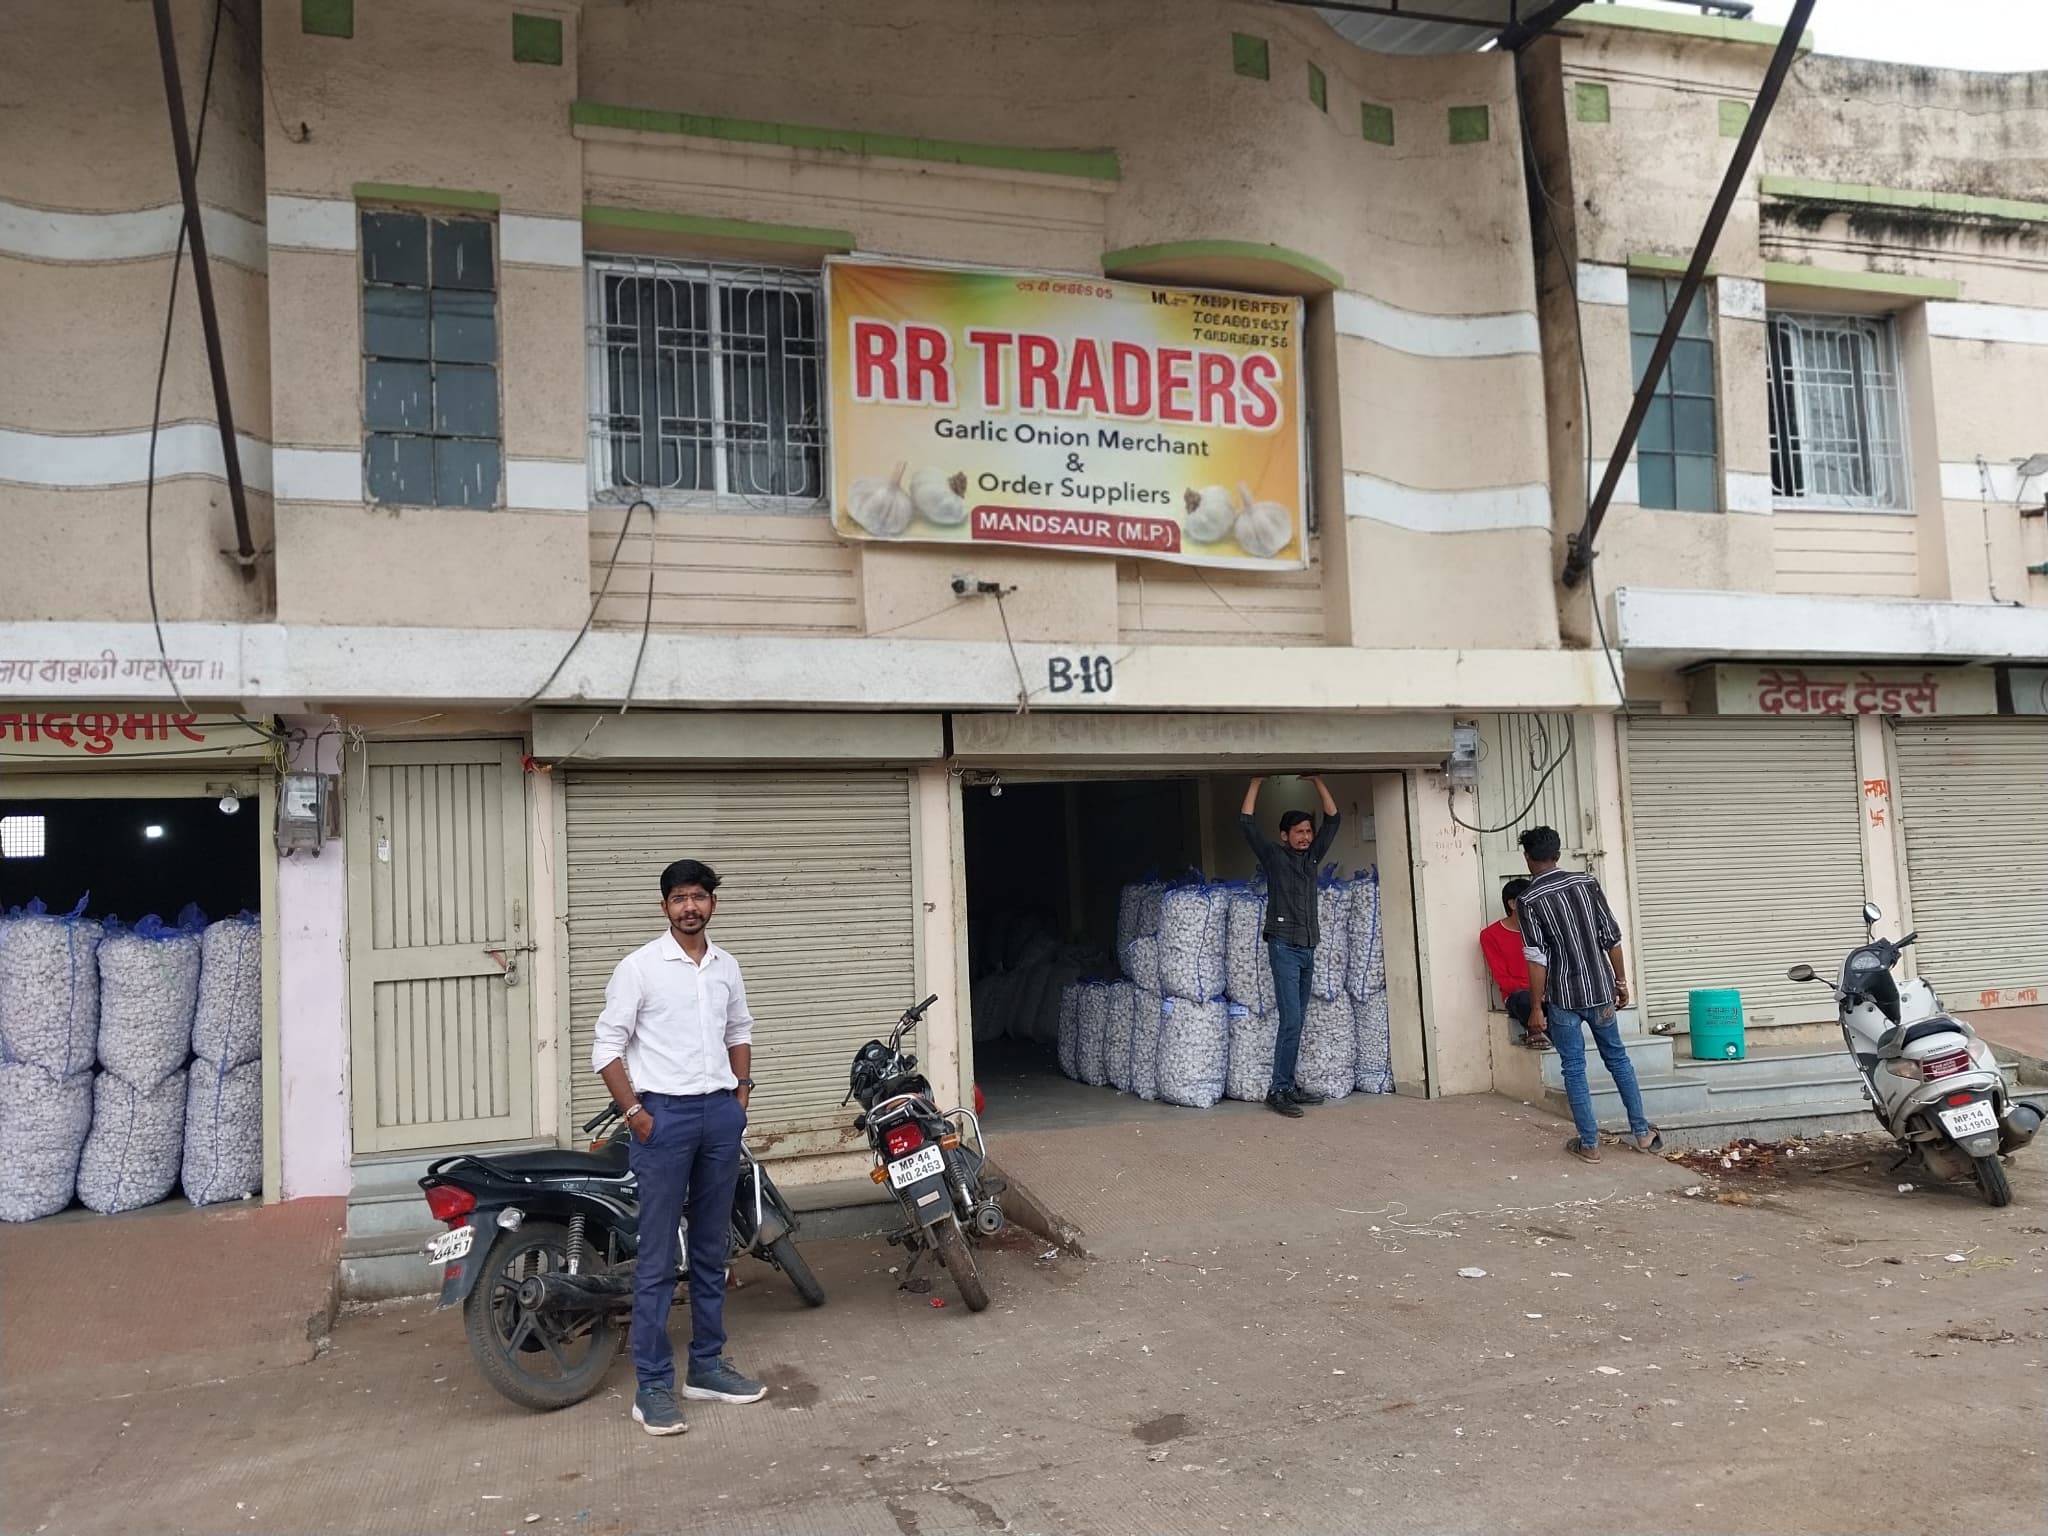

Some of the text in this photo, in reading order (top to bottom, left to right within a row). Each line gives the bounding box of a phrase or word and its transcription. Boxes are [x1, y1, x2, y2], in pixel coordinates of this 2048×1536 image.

[854, 322, 1278, 428] RR TRADERS
[933, 418, 1209, 457] Garlic Onion Merchant
[1066, 453, 1085, 473] &
[978, 473, 1171, 505] Order Suppliers
[979, 511, 1110, 537] MANDSAUR
